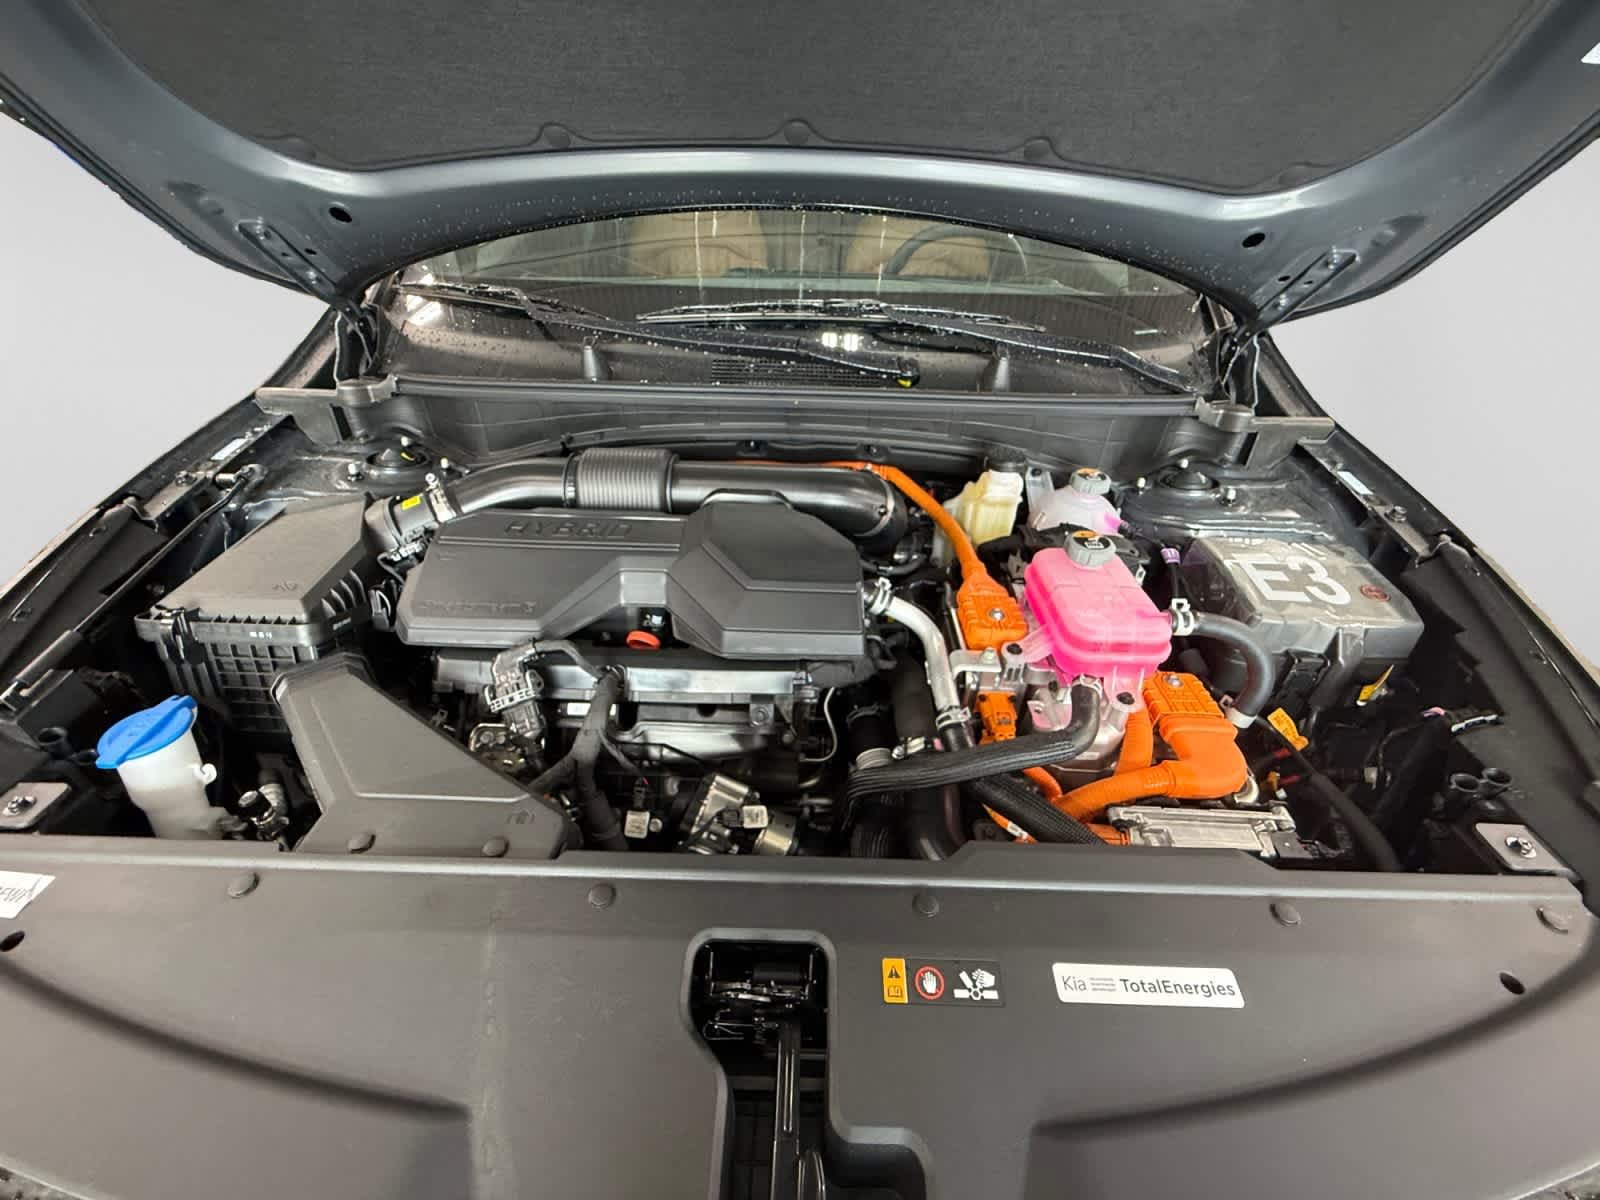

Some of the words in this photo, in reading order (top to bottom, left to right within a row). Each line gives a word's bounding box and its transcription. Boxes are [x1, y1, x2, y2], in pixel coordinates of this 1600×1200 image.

[504, 519, 633, 538] HYBRID
[1230, 553, 1351, 605] E3
[1062, 975, 1087, 992] Kia
[1119, 979, 1236, 998] TotalEnergies
